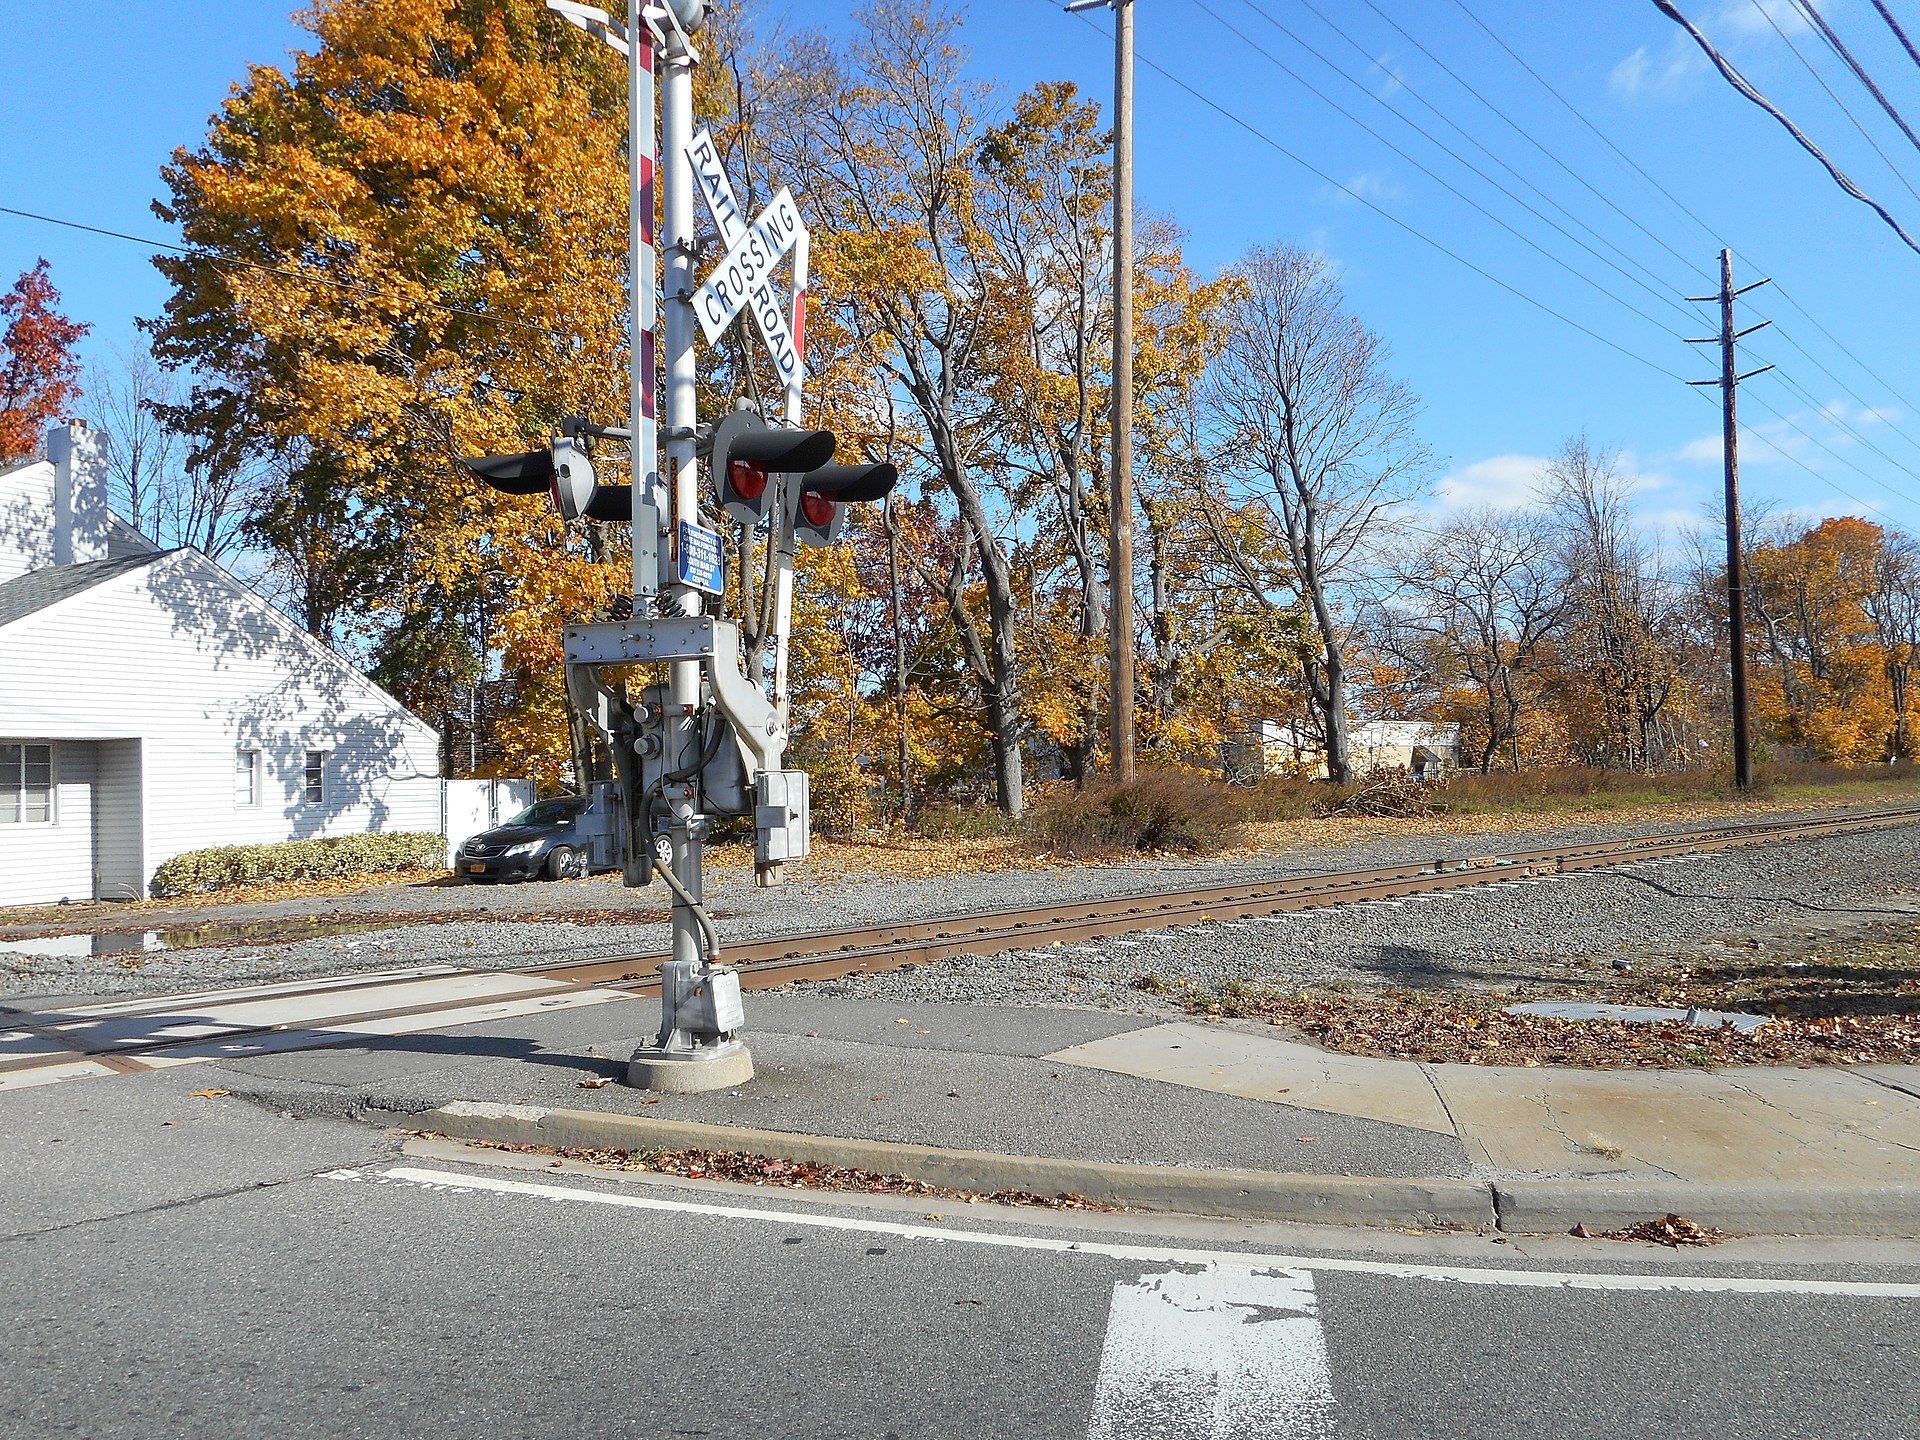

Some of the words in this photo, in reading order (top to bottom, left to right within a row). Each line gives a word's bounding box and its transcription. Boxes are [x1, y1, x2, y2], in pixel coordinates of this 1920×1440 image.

[693, 141, 738, 237] RAIL
[753, 283, 795, 375] ROAD
[705, 203, 794, 326] CROSSING
[691, 529, 713, 544] EMERGENCY
[699, 560, 710, 571] MAIN
[710, 565, 716, 573] ST
